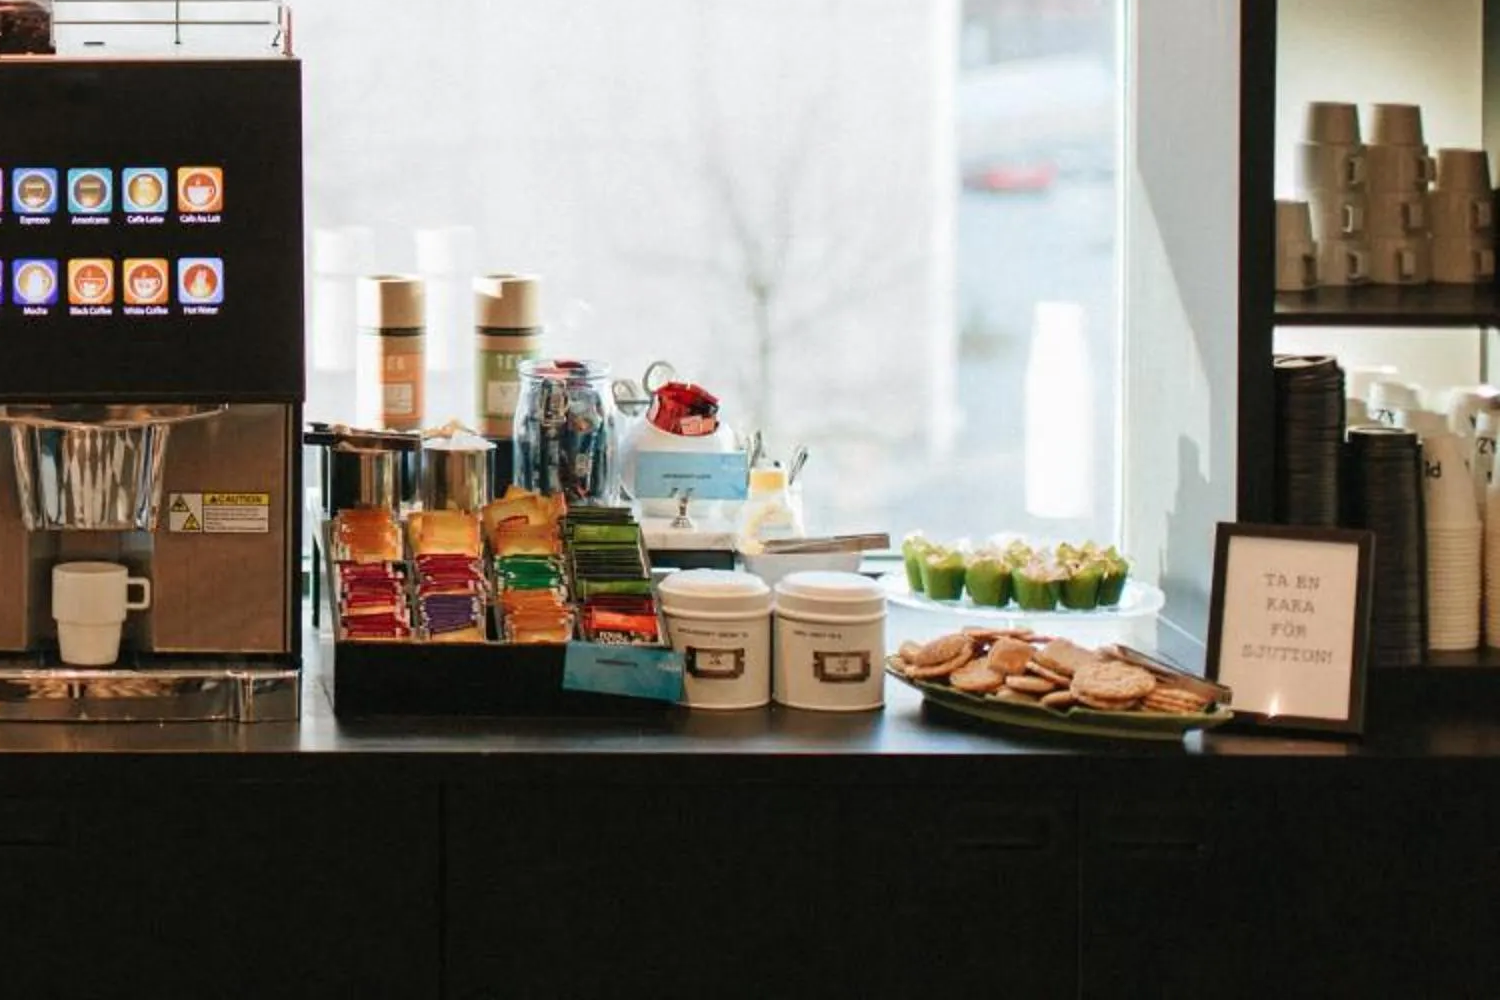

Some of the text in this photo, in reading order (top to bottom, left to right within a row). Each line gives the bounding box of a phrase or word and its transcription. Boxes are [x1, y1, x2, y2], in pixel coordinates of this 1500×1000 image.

[1264, 573, 1321, 591] TA EN
[1270, 620, 1308, 639] FÖR
